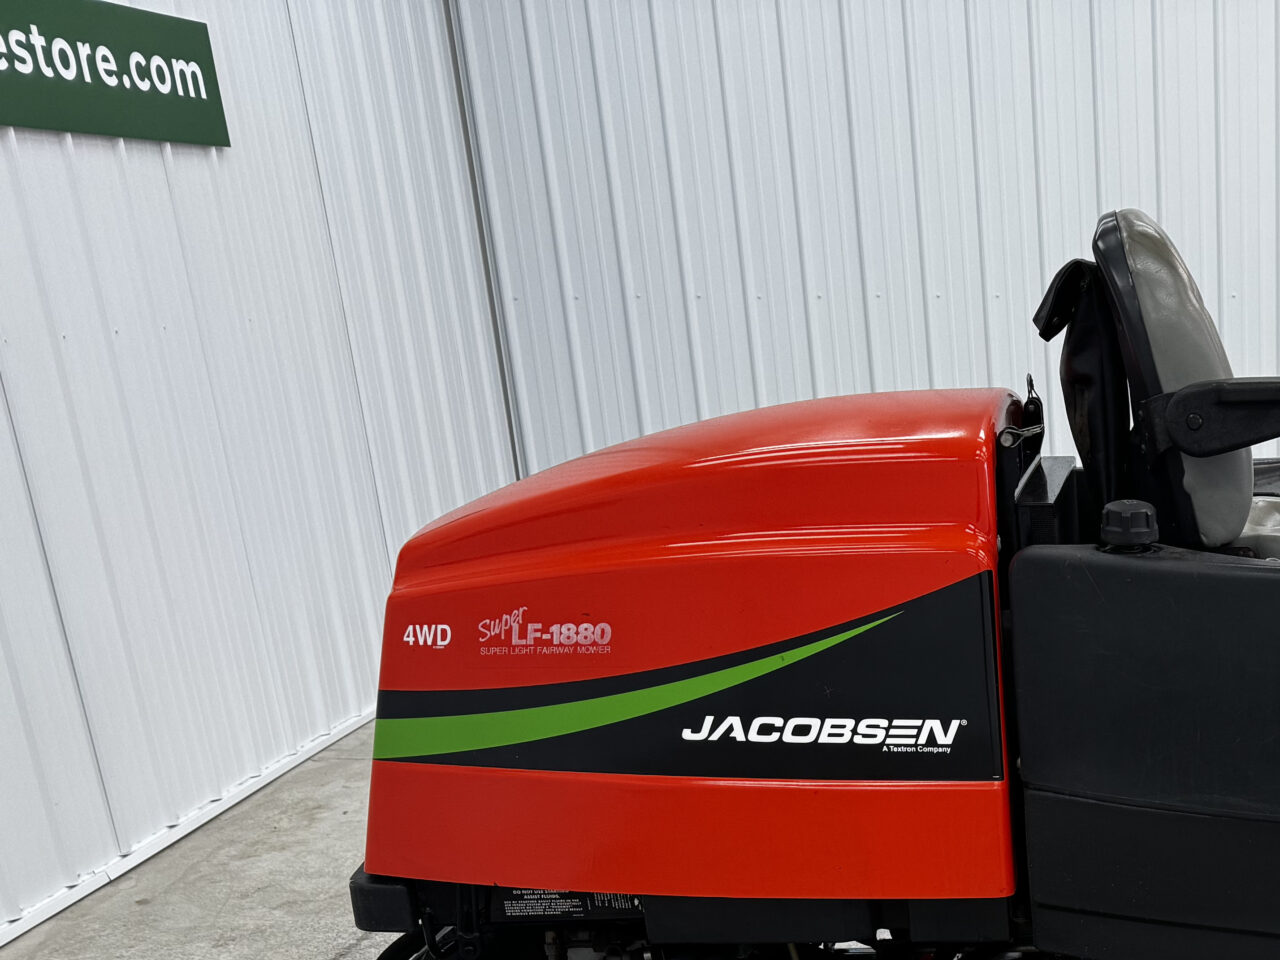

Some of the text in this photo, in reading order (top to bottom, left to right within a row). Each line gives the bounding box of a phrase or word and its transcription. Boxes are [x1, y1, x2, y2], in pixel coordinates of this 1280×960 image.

[403, 624, 452, 646] 4WD
[478, 606, 528, 642] Super
[512, 622, 612, 645] LF-1880
[480, 645, 611, 656] SUPER LIGHT FAIRWAY MOWER
[681, 715, 961, 745] JACOBSEN
[917, 745, 951, 754] Company
